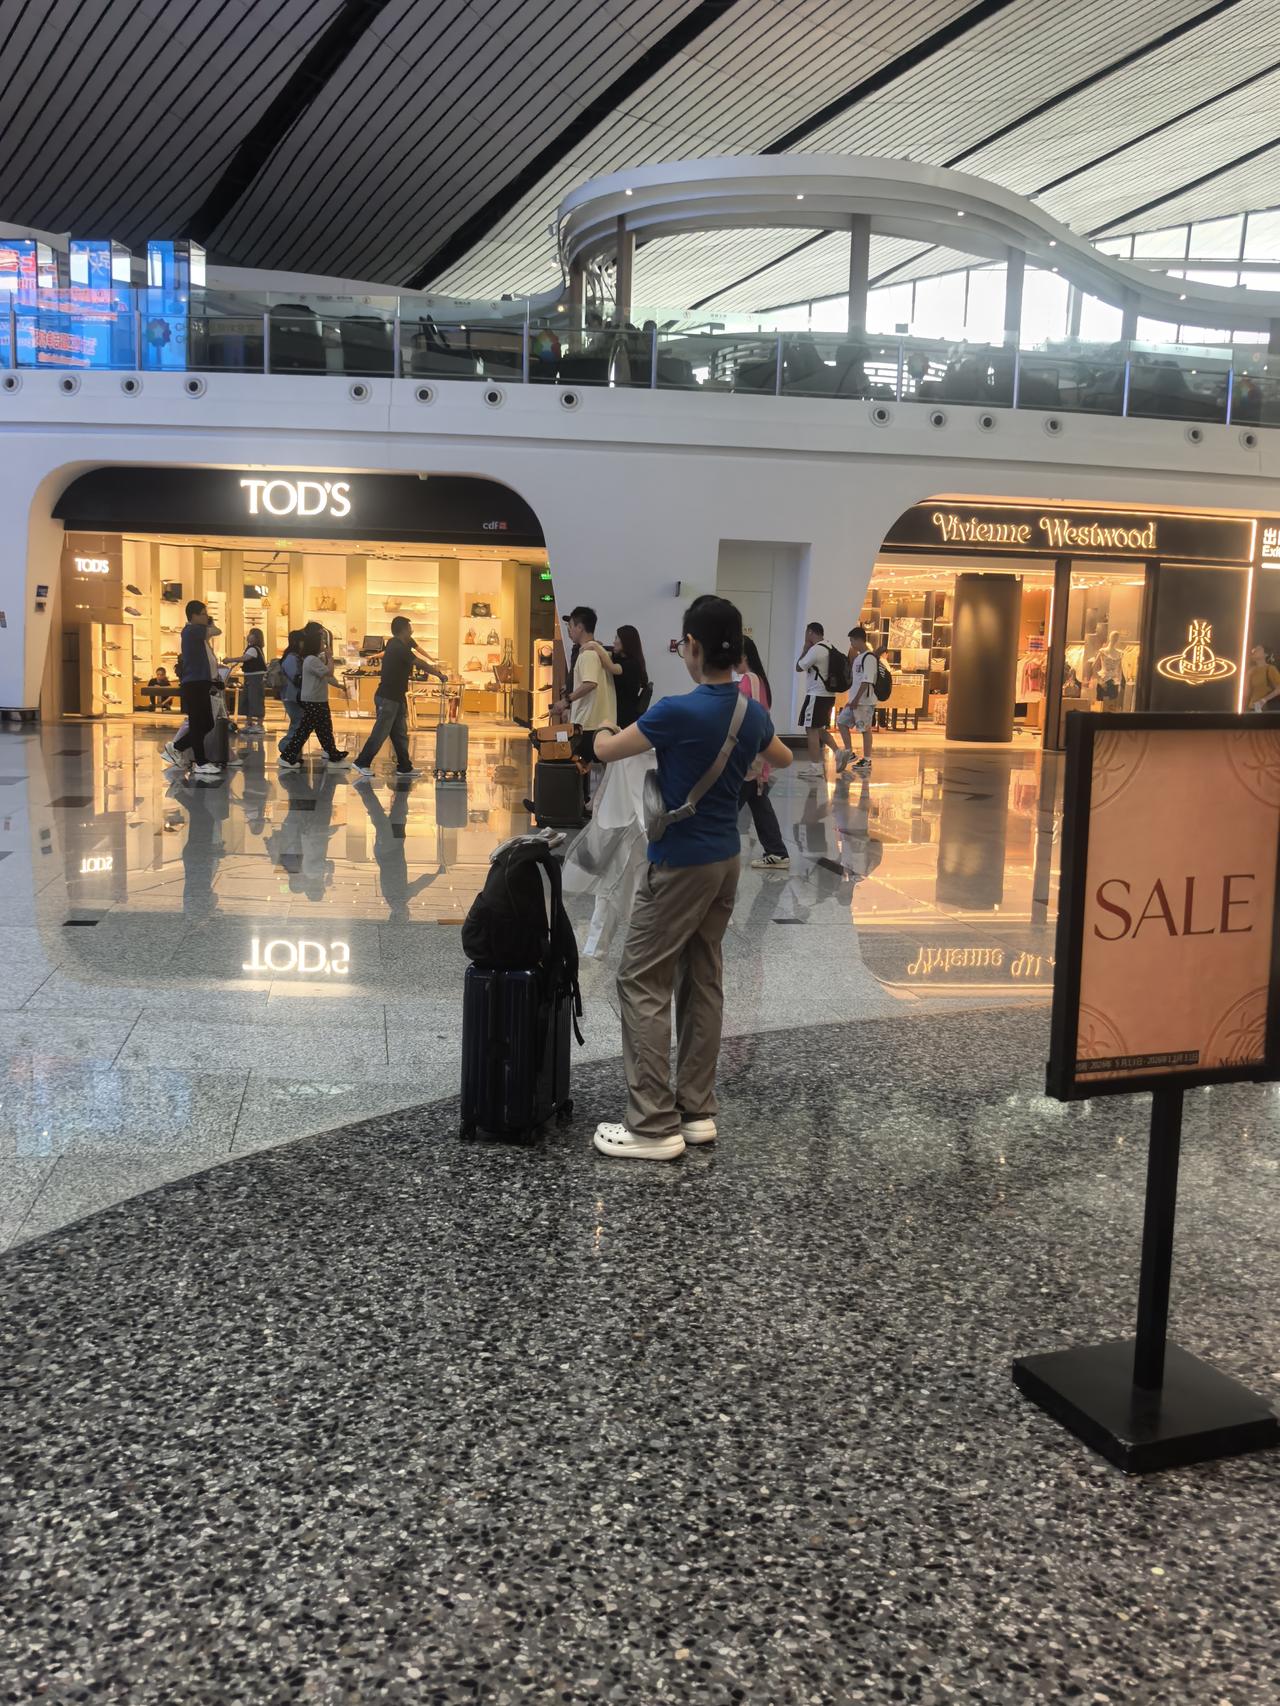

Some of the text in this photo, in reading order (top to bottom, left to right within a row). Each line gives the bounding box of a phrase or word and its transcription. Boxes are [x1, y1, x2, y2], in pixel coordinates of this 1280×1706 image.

[240, 479, 351, 517] TOD'S
[933, 512, 1157, 549] Vivienne Westwood
[1262, 527, 1280, 546] 出
[1094, 874, 1255, 941] SALE
